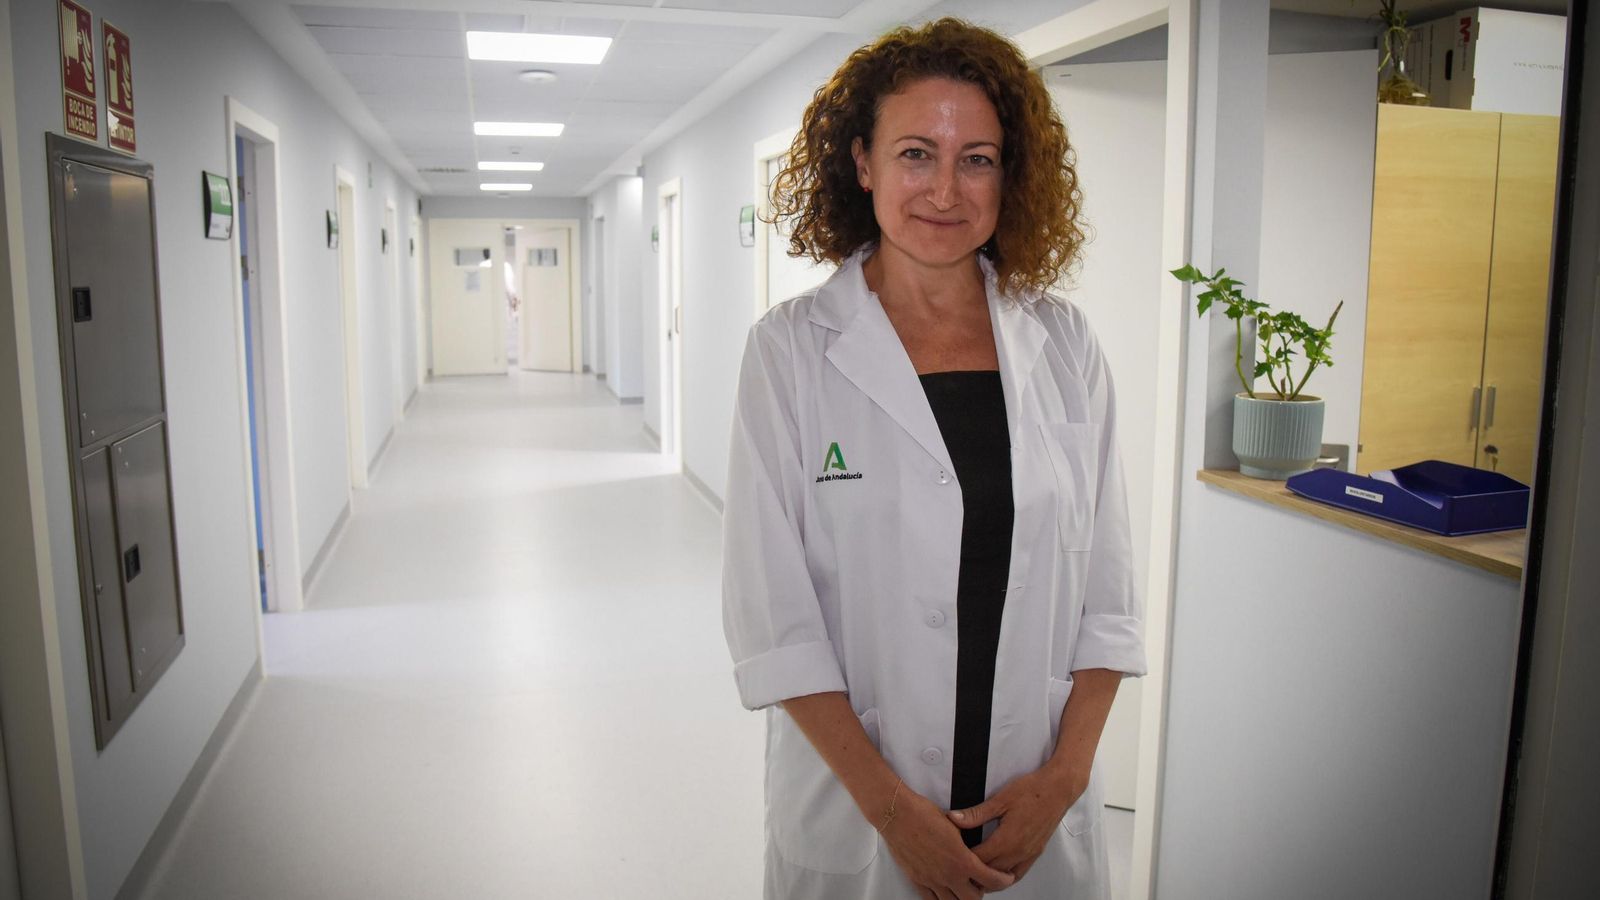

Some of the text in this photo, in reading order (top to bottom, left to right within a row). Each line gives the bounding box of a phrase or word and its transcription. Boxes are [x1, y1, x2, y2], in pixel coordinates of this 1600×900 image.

[69, 98, 94, 120] BOCA DE
[68, 113, 96, 136] INCENDIO
[832, 472, 862, 480] Andalucía
